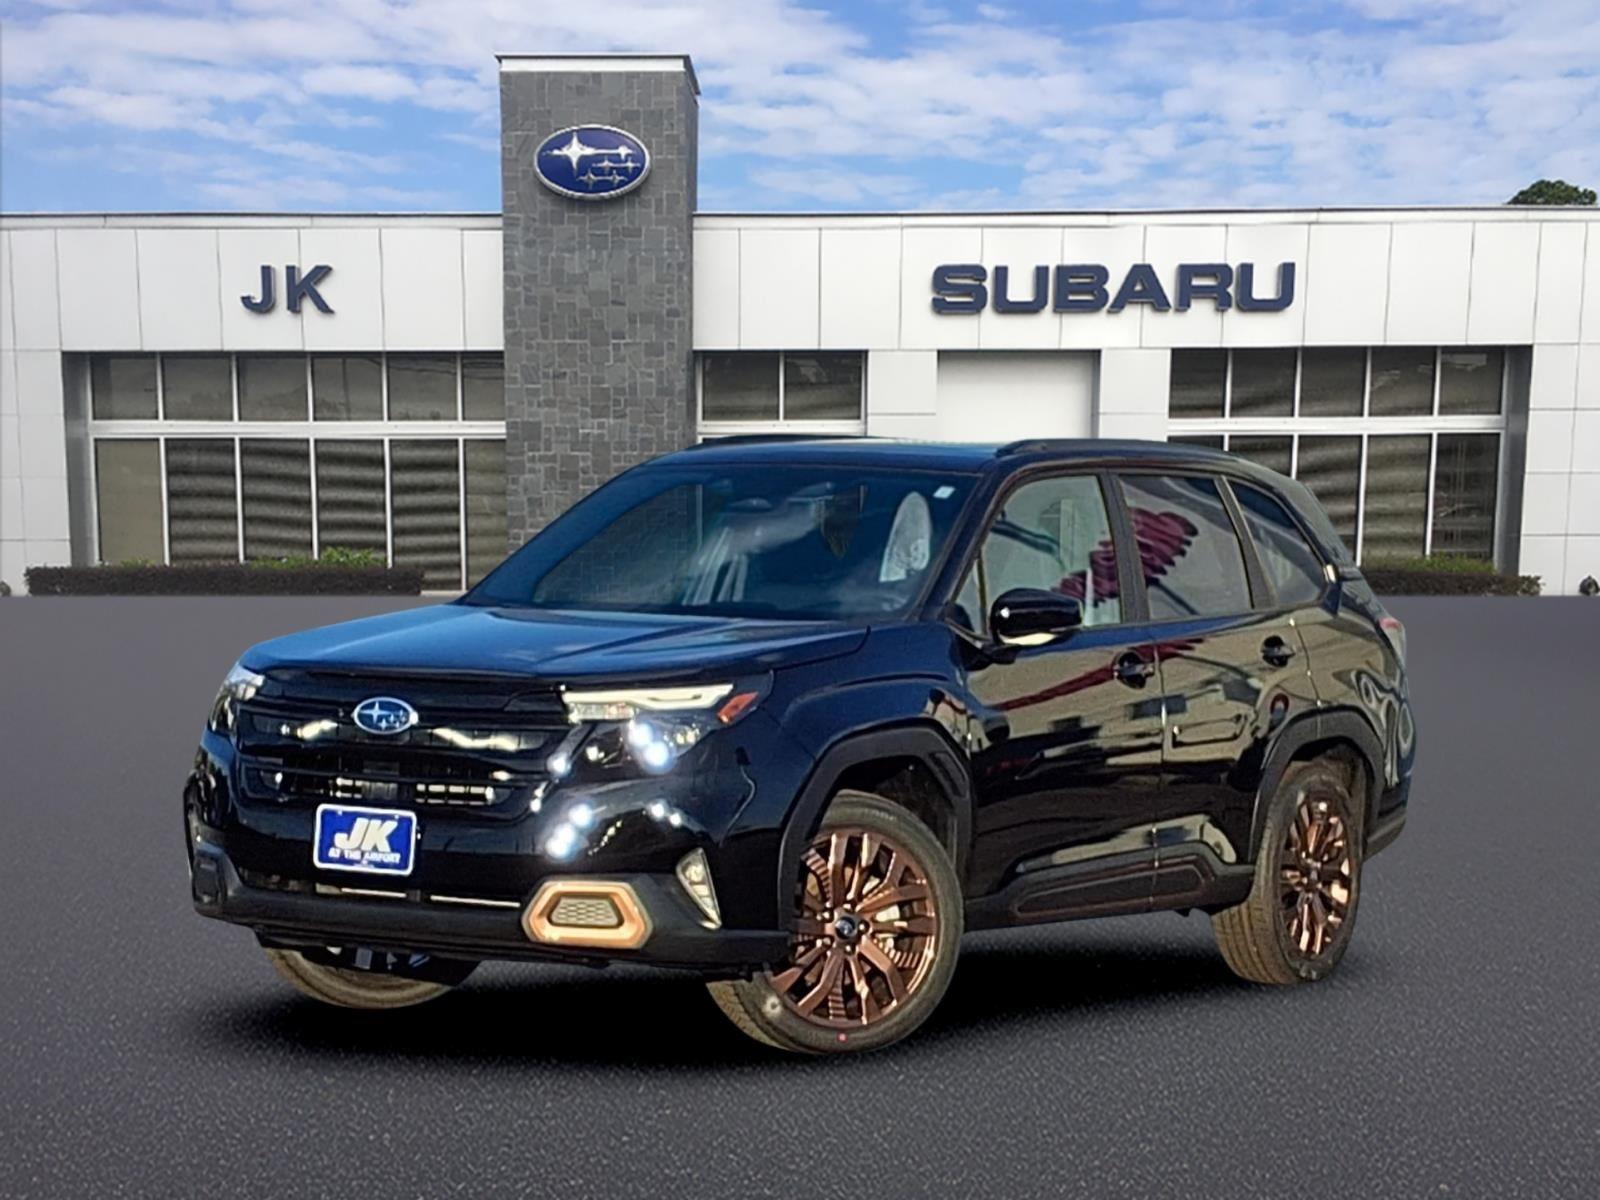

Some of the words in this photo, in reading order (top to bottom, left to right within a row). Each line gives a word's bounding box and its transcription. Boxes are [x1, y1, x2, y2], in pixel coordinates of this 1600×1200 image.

[240, 264, 335, 314] JK
[932, 262, 1296, 315] SUBARU
[334, 818, 397, 851] JK
